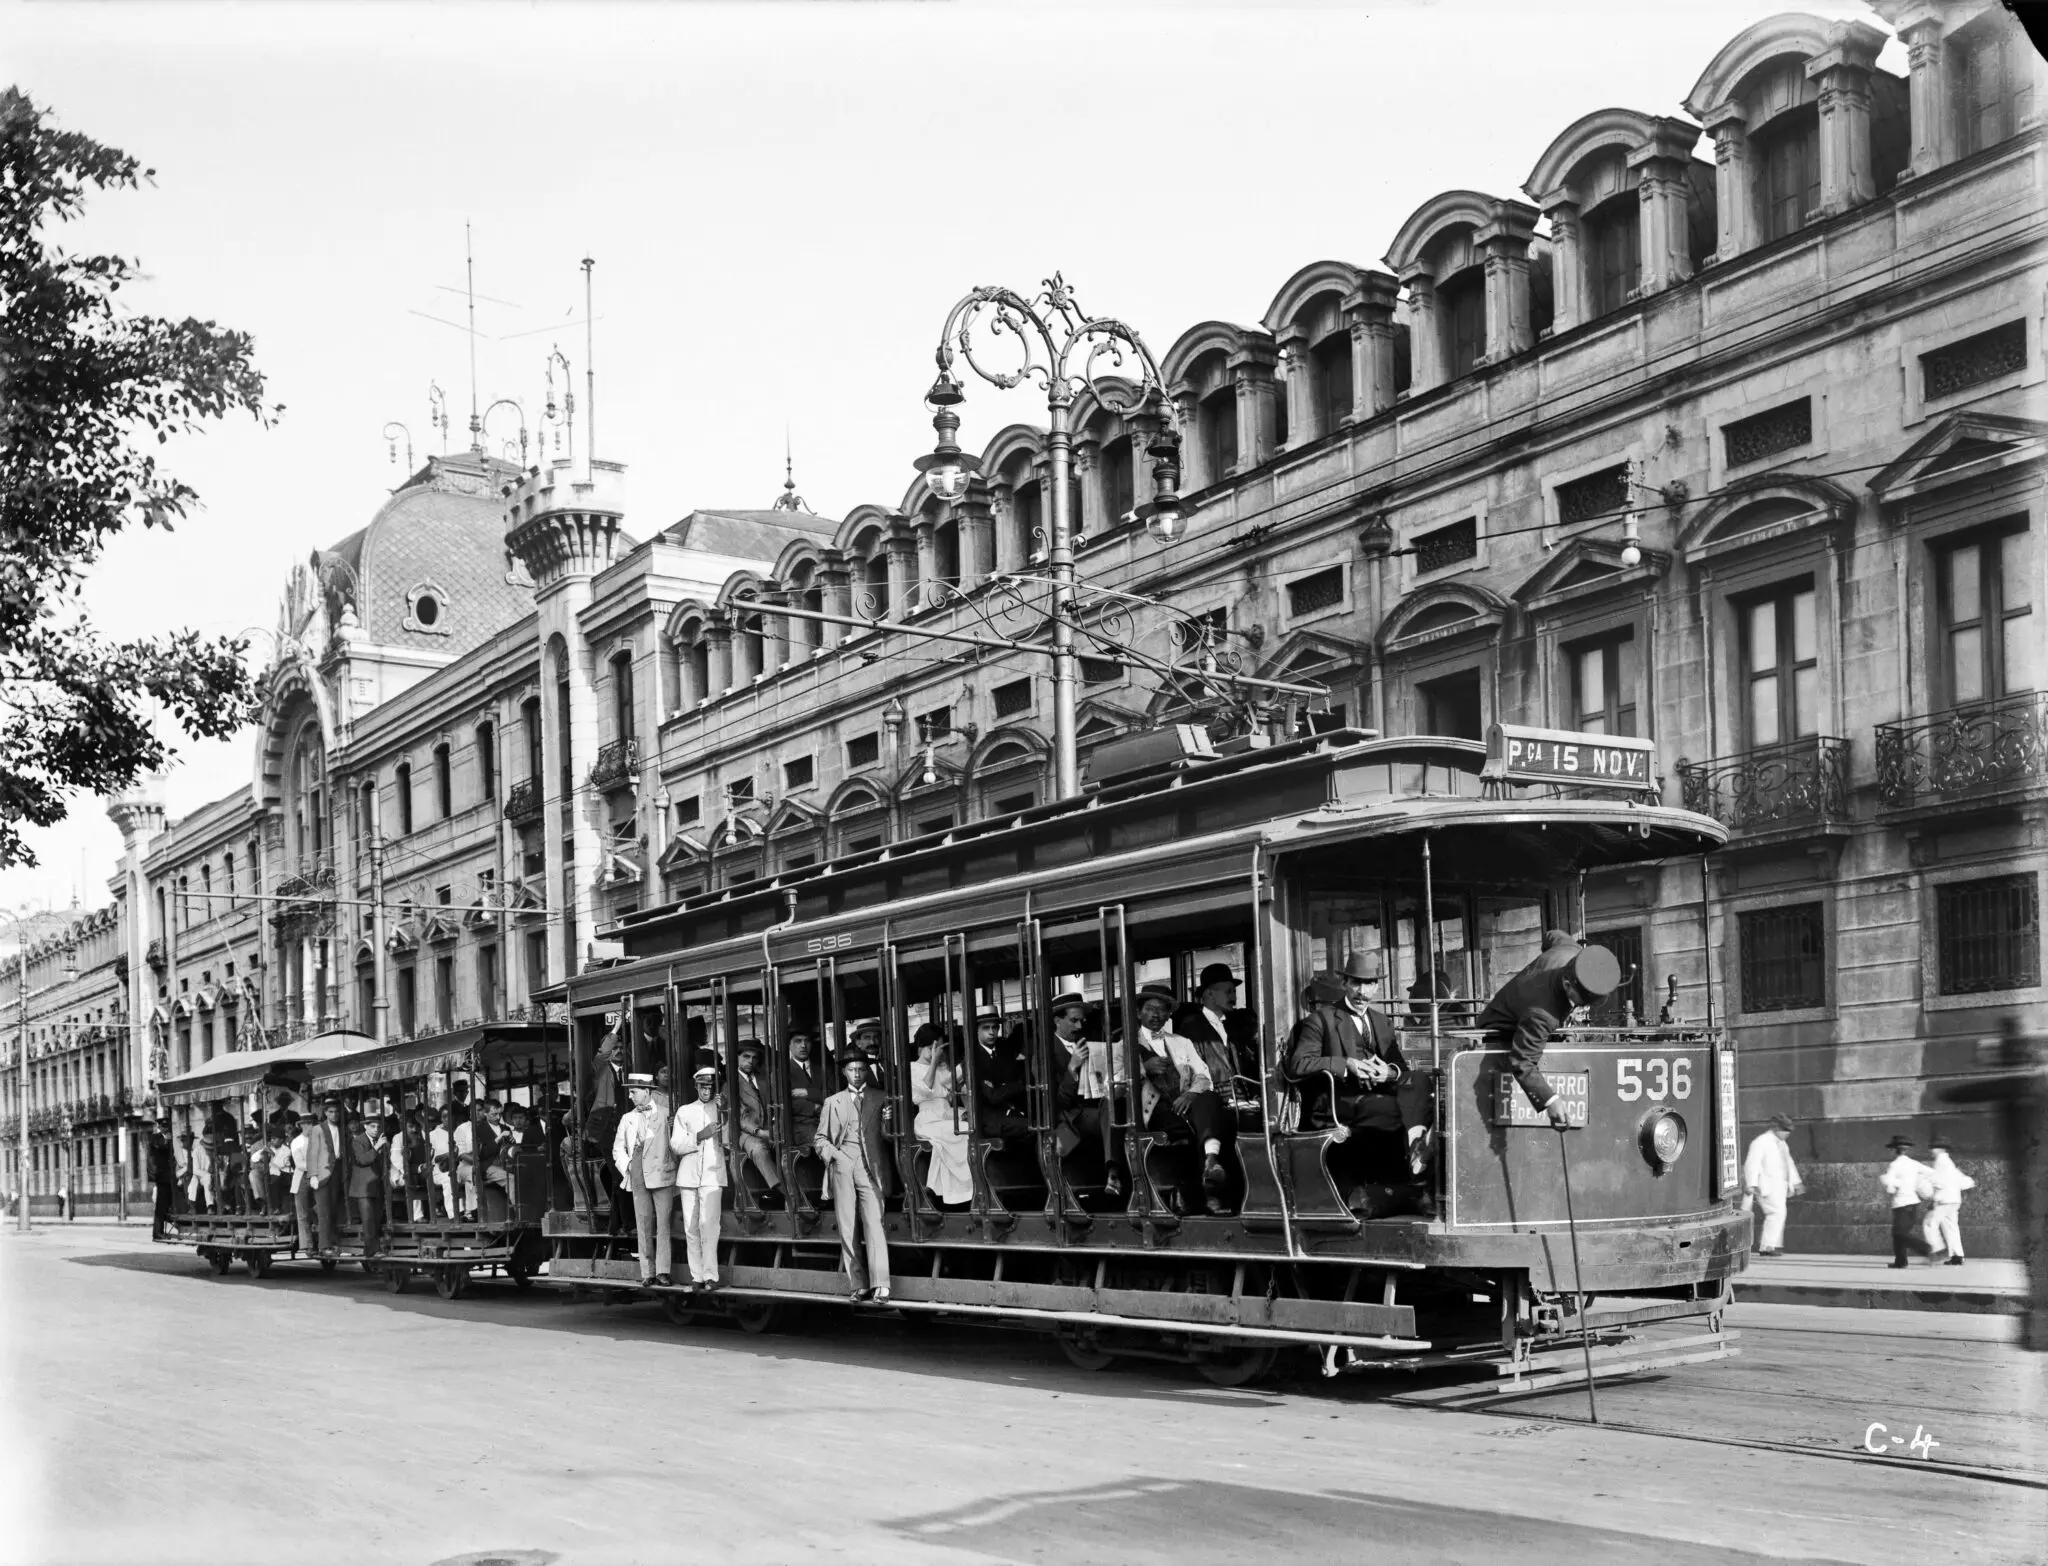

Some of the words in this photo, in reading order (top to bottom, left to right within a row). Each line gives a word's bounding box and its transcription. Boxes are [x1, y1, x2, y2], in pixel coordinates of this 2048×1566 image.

[1553, 745, 1579, 771] 15
[808, 933, 852, 952] 536
[1617, 1057, 1692, 1102] 536
